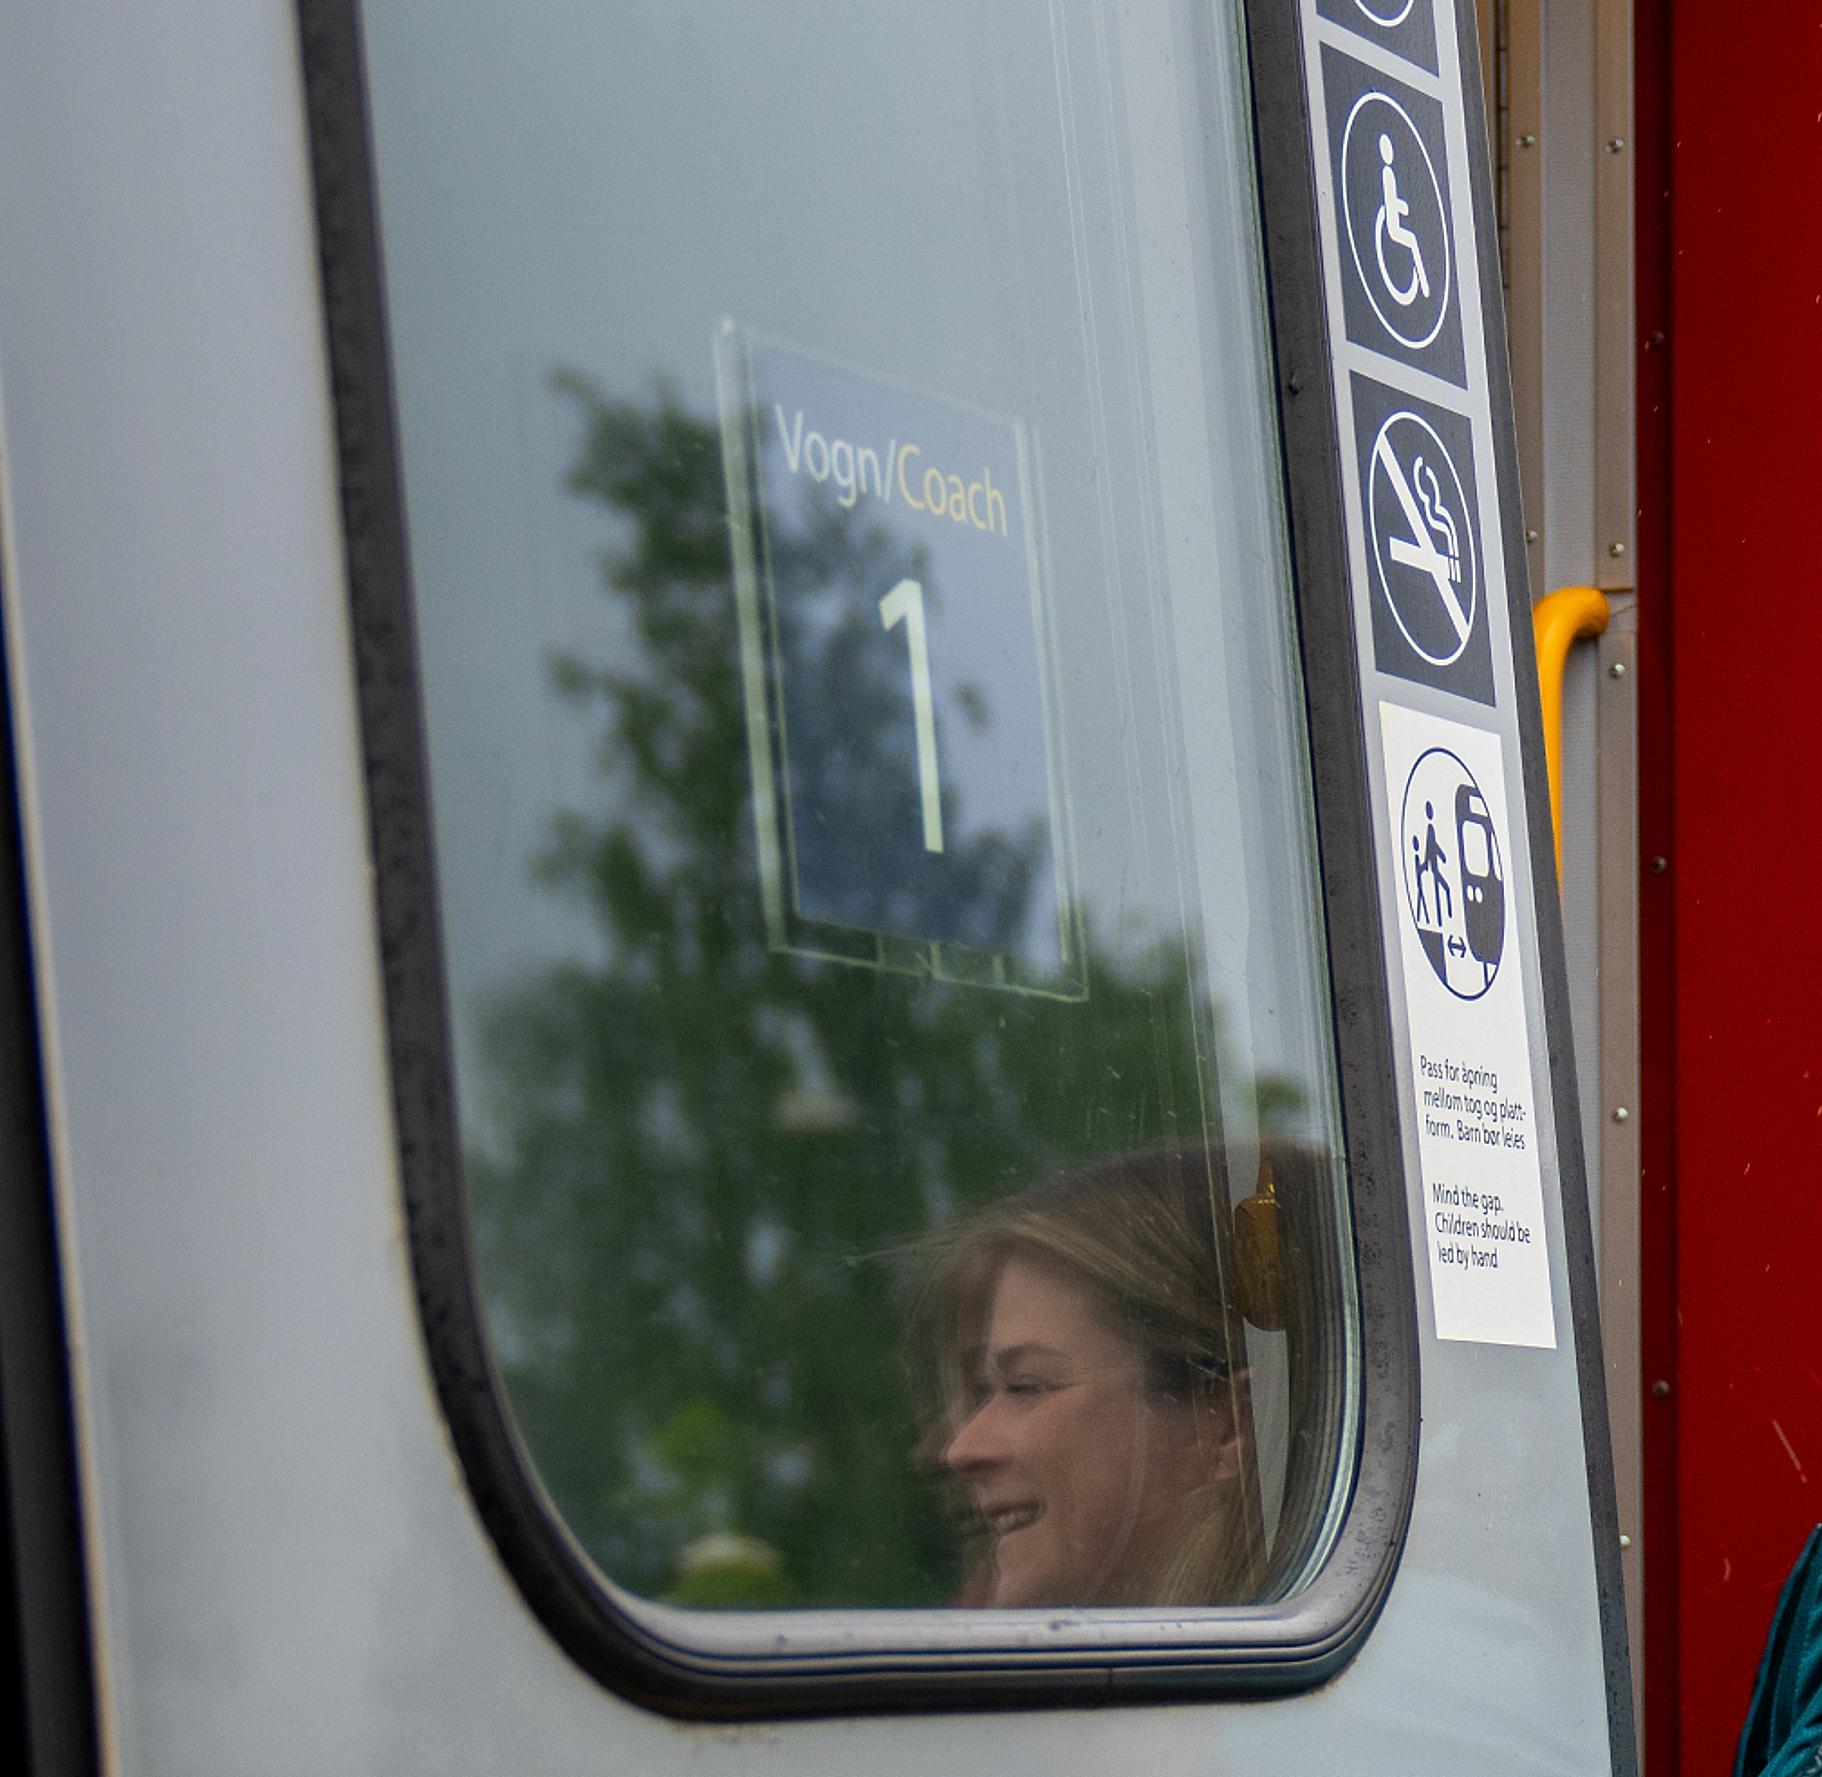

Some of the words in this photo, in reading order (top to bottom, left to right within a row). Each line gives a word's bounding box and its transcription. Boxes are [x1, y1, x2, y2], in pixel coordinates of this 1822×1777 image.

[775, 404, 1008, 537] Vogn/Coach
[878, 578, 944, 854] 1
[1420, 1055, 1443, 1080] Pass
[1444, 1058, 1459, 1081] for
[1423, 1087, 1463, 1112] mellom
[1464, 1094, 1483, 1120] tog
[1484, 1100, 1497, 1122] og
[1426, 1114, 1454, 1139] form.
[1457, 1119, 1480, 1142] Barn
[1502, 1125, 1526, 1150] leies
[1432, 1183, 1459, 1206] Mind
[1461, 1186, 1479, 1209] the
[1481, 1193, 1504, 1216] gap.
[1435, 1212, 1479, 1238] Children
[1481, 1217, 1515, 1241] should
[1516, 1220, 1531, 1244] be
[1437, 1241, 1454, 1264] led
[1455, 1243, 1470, 1270] by
